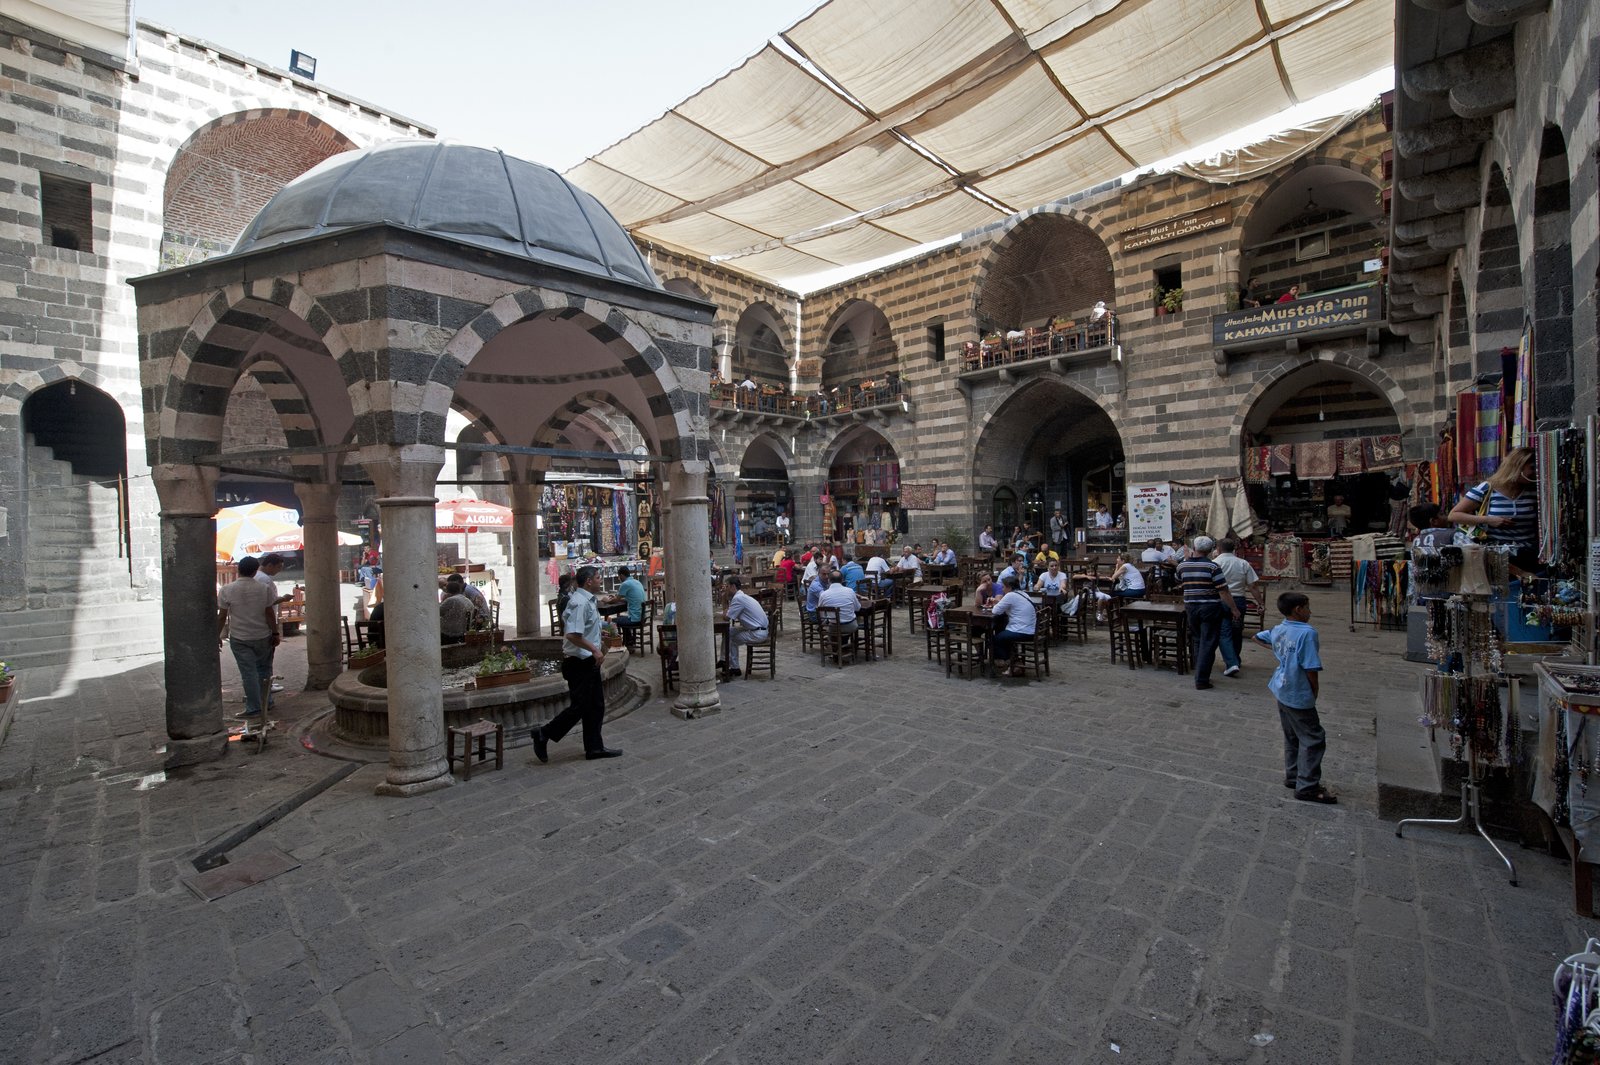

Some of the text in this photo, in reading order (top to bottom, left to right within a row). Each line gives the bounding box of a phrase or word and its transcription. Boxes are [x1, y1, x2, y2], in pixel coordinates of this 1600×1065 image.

[1124, 217, 1226, 250] KAHVALTI DÜNYASI
[1224, 308, 1368, 341] KAHVALTI DÜNYASI
[465, 515, 502, 524] ALGIDA
